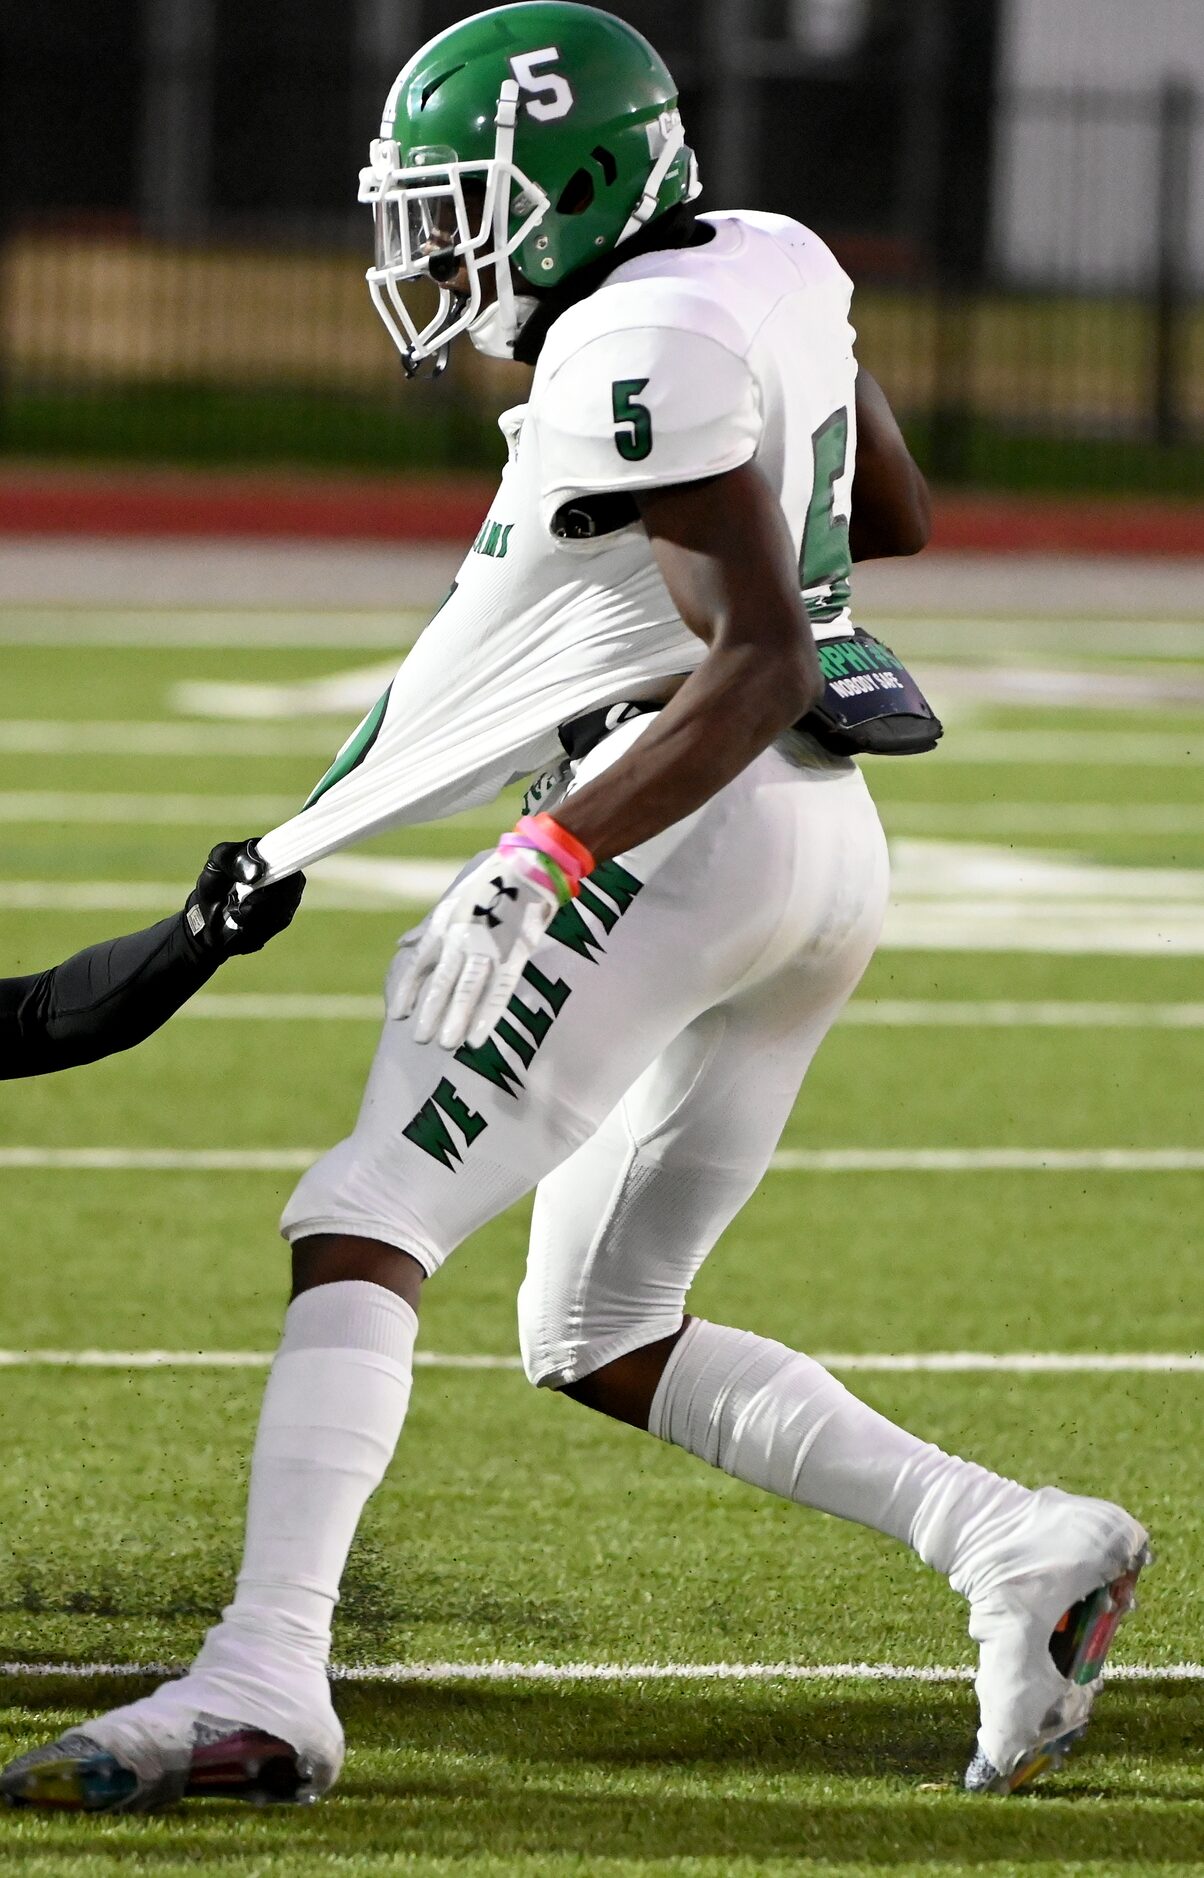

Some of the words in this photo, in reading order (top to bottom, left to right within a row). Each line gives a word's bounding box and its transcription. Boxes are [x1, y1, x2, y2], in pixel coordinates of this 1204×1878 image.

[510, 46, 574, 122] 5
[612, 378, 653, 461] 5
[829, 673, 880, 698] NOBODY
[402, 1076, 488, 1174] WE
[453, 960, 572, 1100] WILL
[545, 858, 645, 966] WIN
